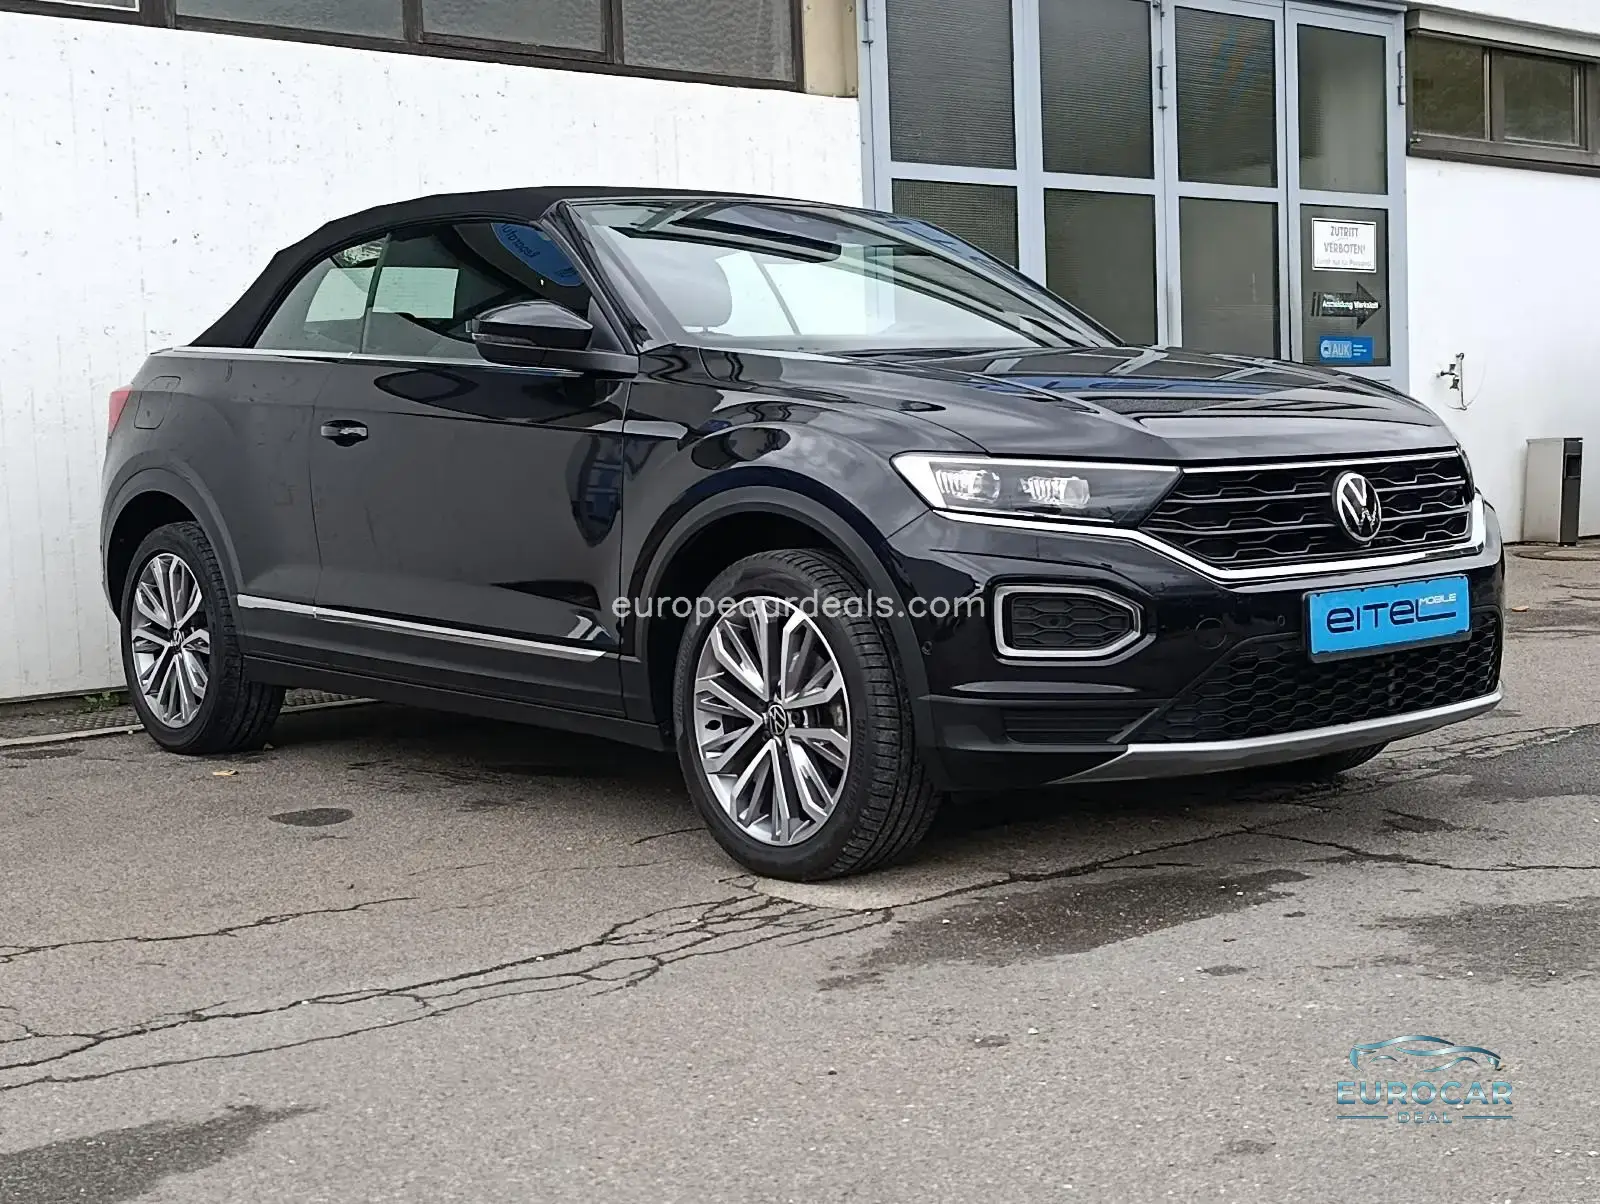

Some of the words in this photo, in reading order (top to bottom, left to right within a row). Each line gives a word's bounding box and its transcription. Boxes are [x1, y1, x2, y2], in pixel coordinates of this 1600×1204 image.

[1330, 226, 1359, 238] ZUTRITT
[1323, 242, 1366, 255] VERBOTEN!
[1419, 592, 1457, 605] MOBILE
